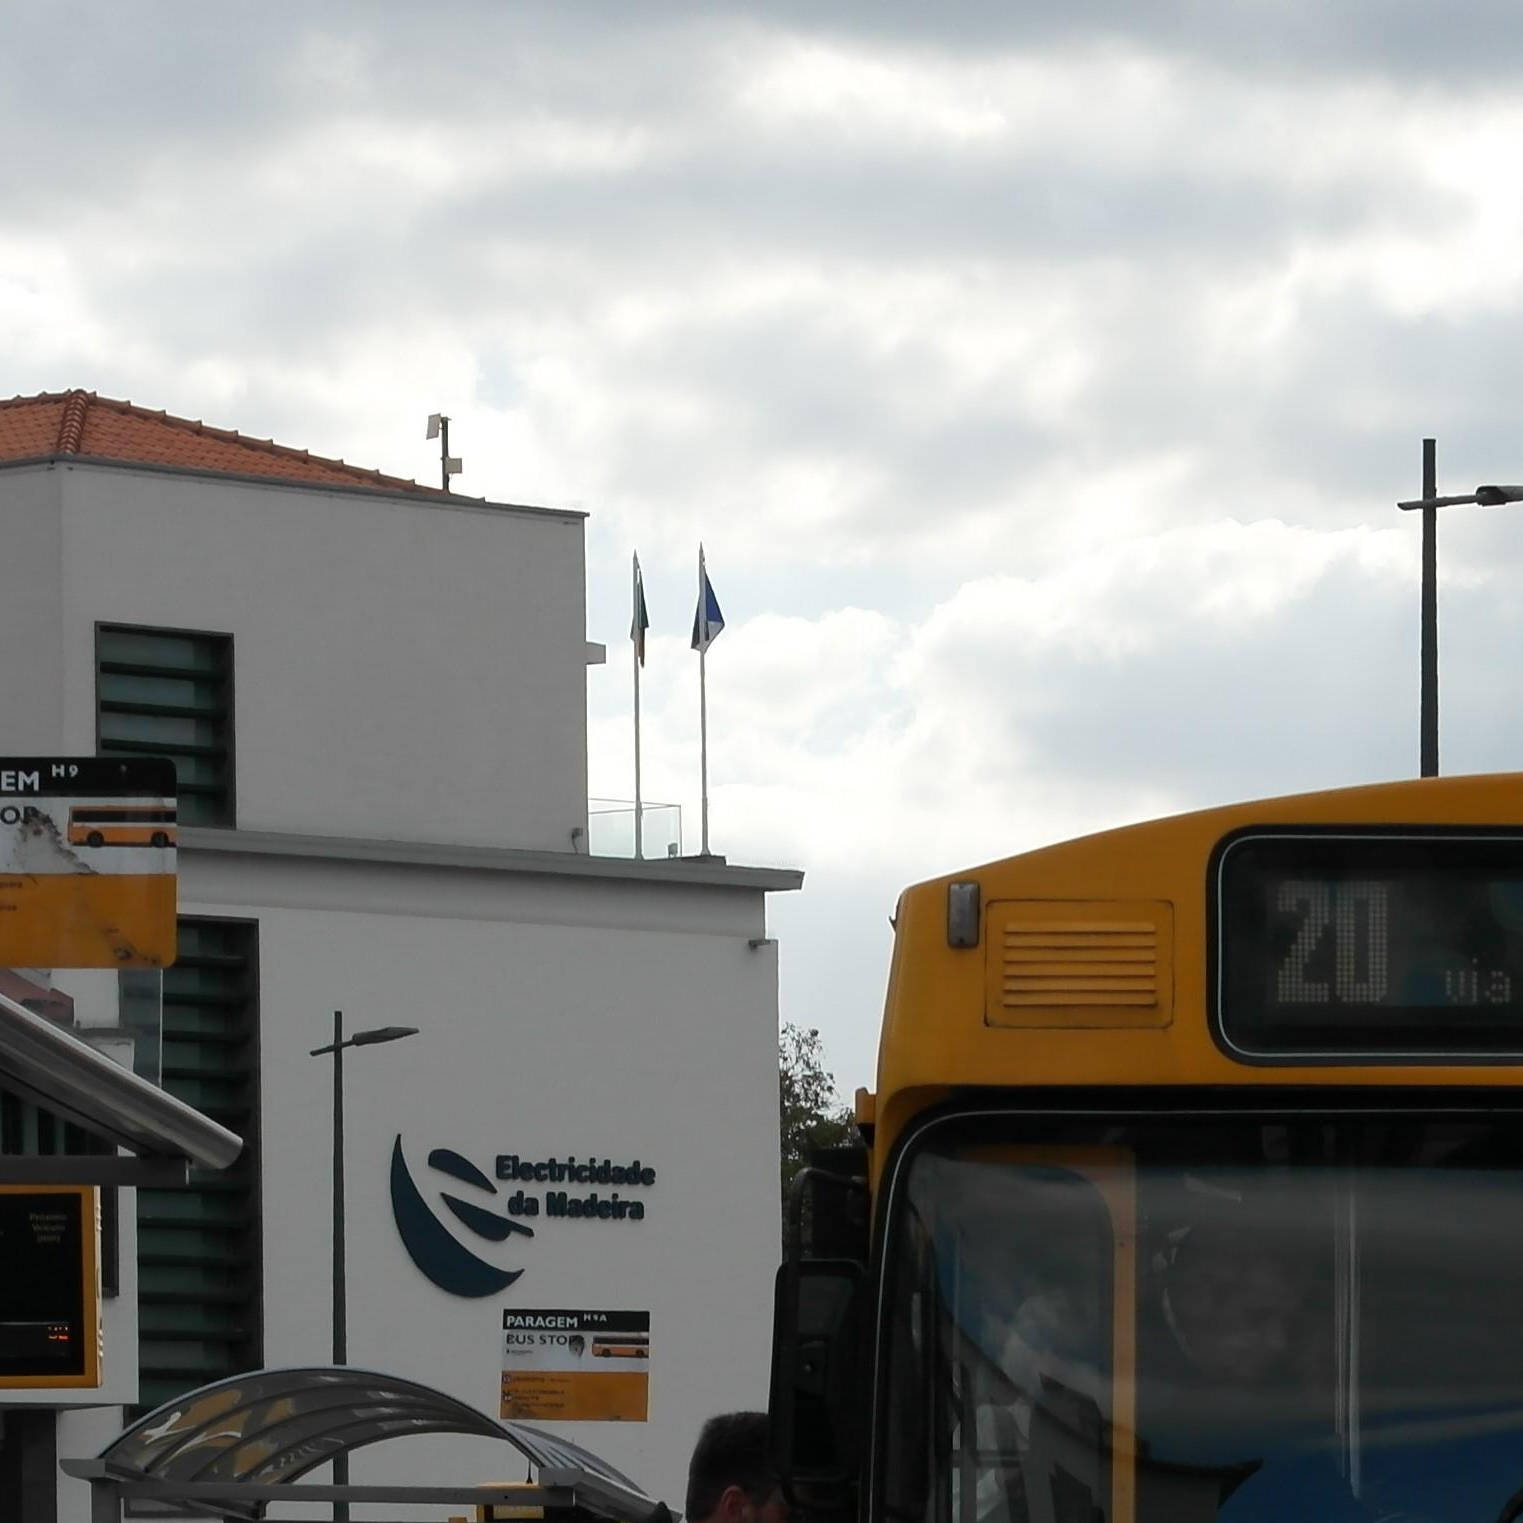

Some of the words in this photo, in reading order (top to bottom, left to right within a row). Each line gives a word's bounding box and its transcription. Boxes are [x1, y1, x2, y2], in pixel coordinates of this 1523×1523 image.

[1277, 881, 1388, 1002] 20
[1444, 957, 1511, 1003] via
[496, 1155, 656, 1185] Electricidade
[508, 1190, 539, 1216] da
[546, 1192, 644, 1219] Madeira
[506, 1315, 578, 1328] PARAGEM
[506, 1334, 535, 1345] BUS
